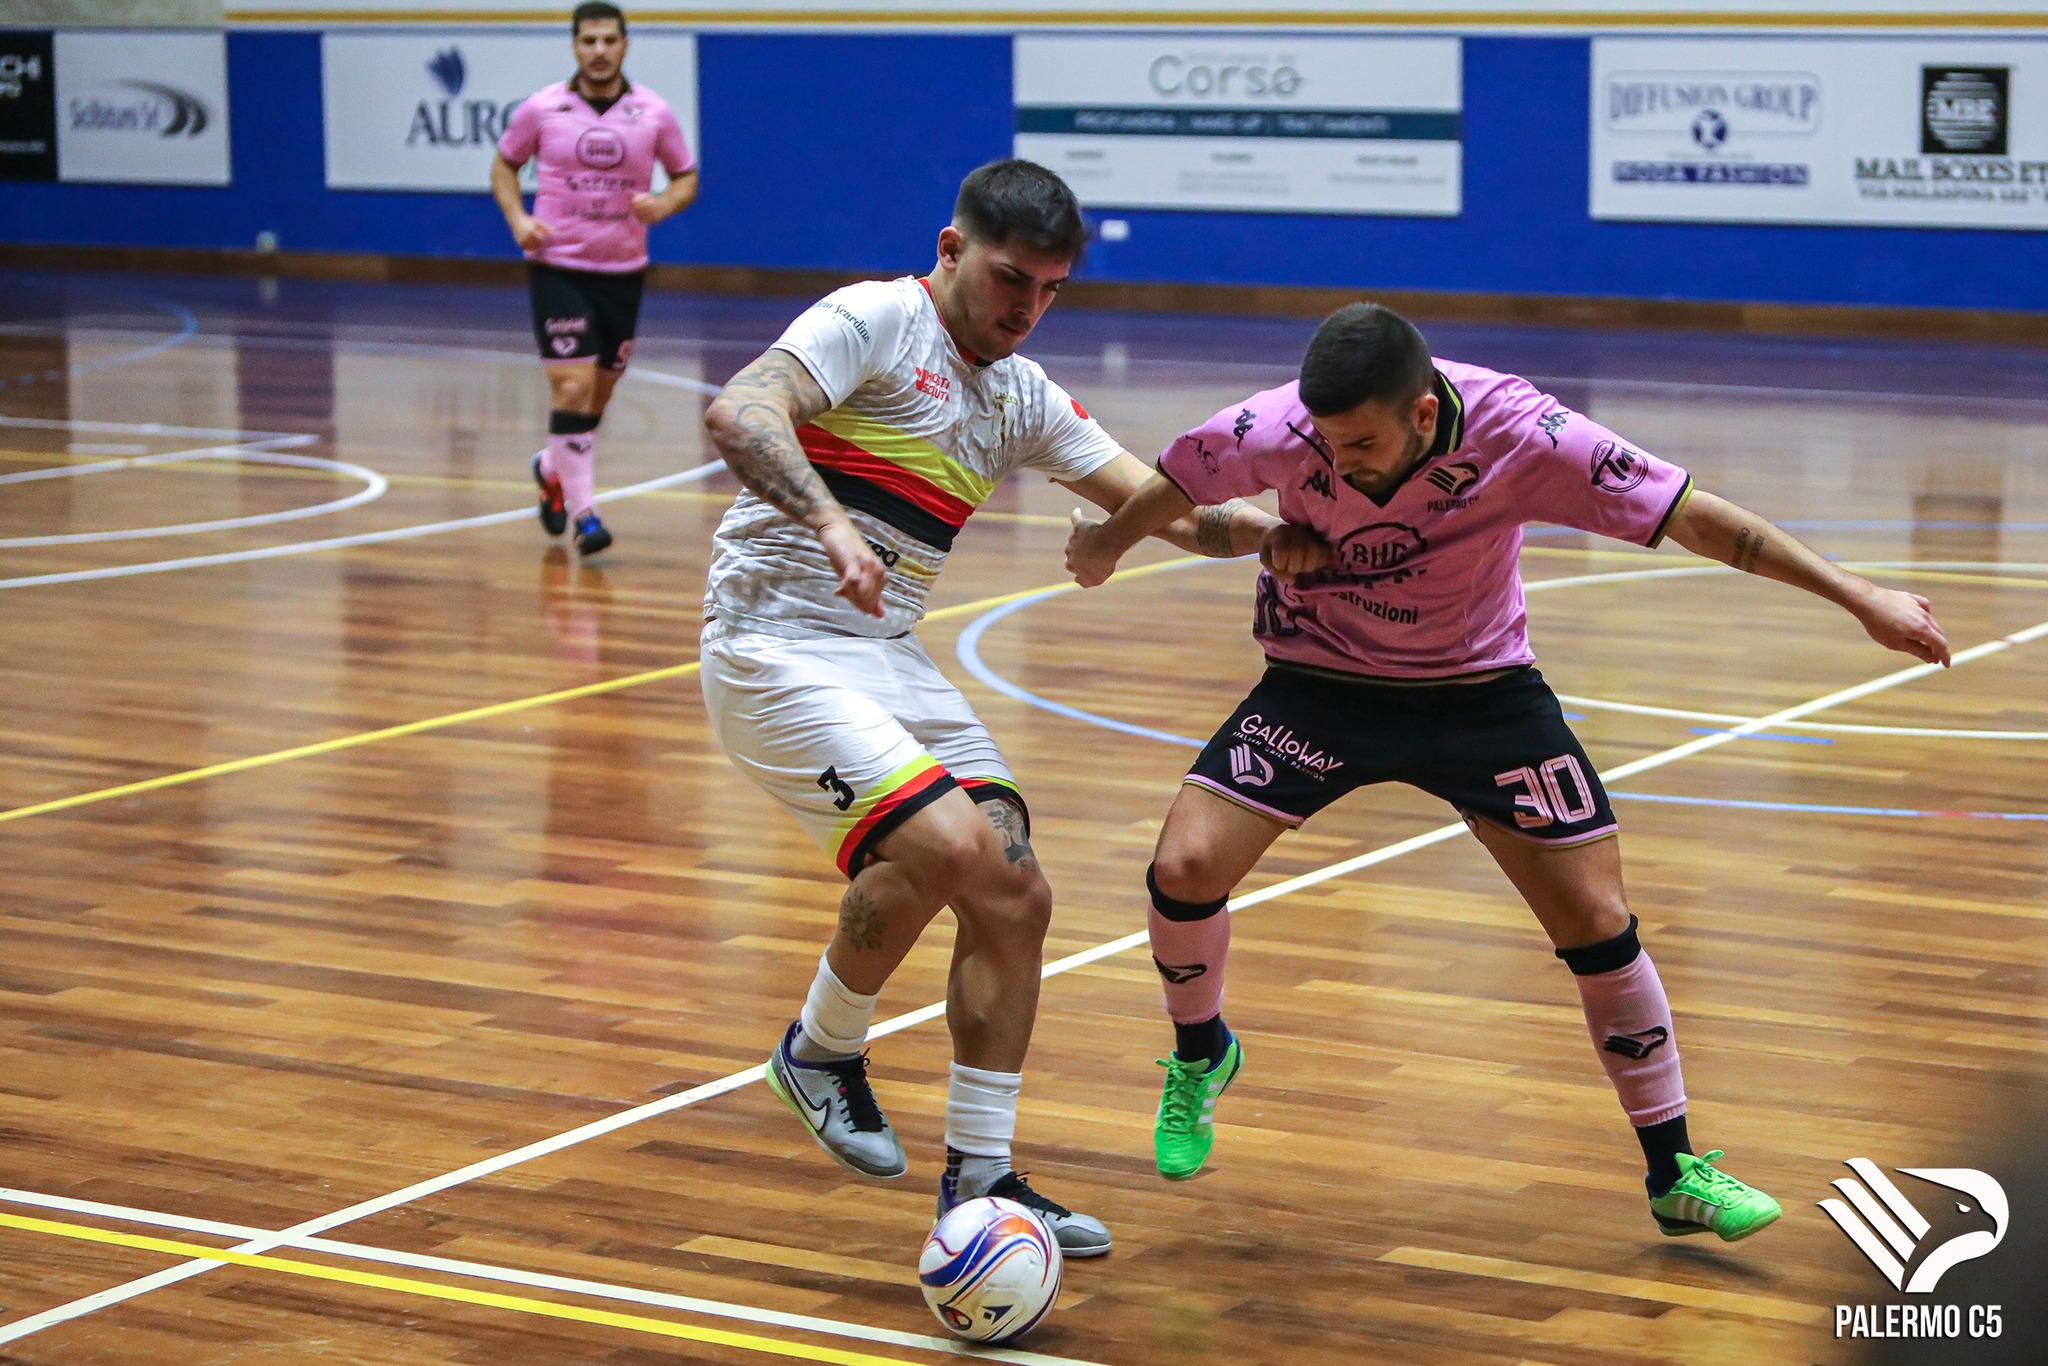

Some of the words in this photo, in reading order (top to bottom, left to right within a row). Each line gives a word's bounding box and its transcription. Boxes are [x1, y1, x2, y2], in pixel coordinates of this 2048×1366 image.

[1855, 157, 1924, 179] MAIL
[1931, 159, 2014, 183] BOXES
[816, 765, 855, 812] 3
[1494, 754, 1597, 829] 30
